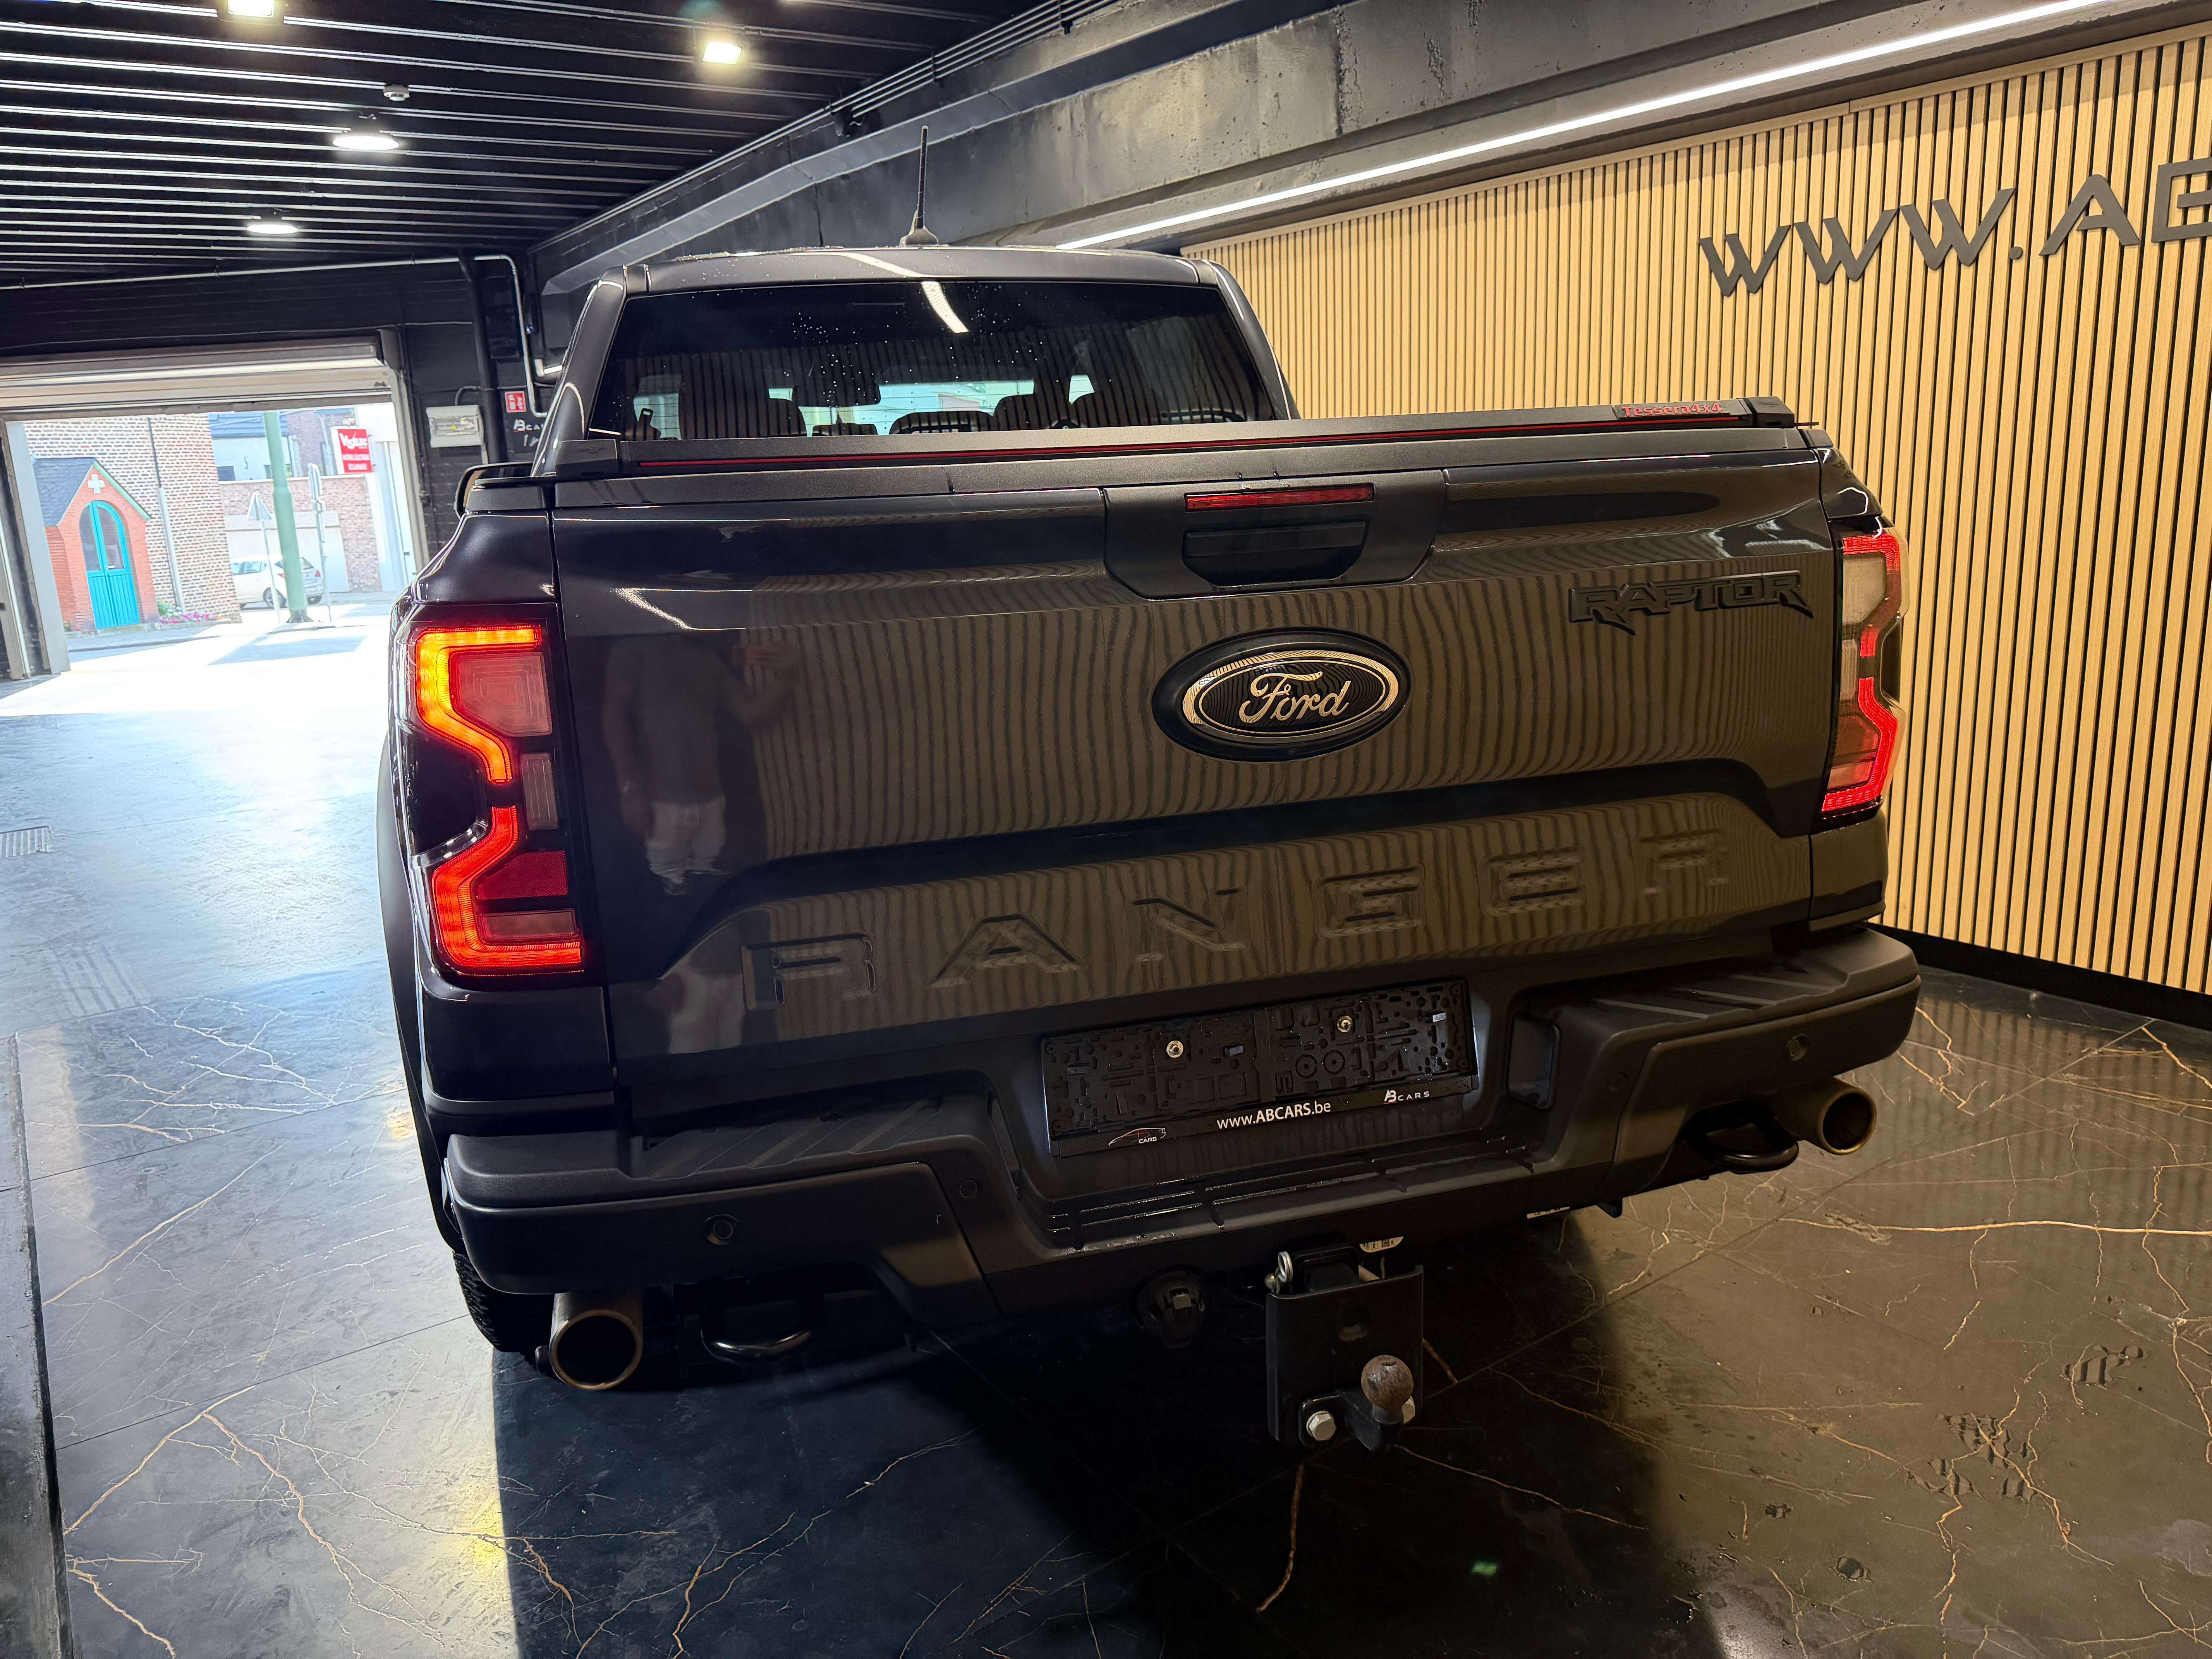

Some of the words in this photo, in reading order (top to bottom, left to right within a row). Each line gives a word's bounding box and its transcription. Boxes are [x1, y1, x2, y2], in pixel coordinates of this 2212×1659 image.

[1568, 570, 1814, 636] RAPTOR
[1239, 671, 1351, 724] Ford
[740, 827, 1733, 1011] RANGER
[1217, 1101, 1331, 1130] www.ABCARS.be
